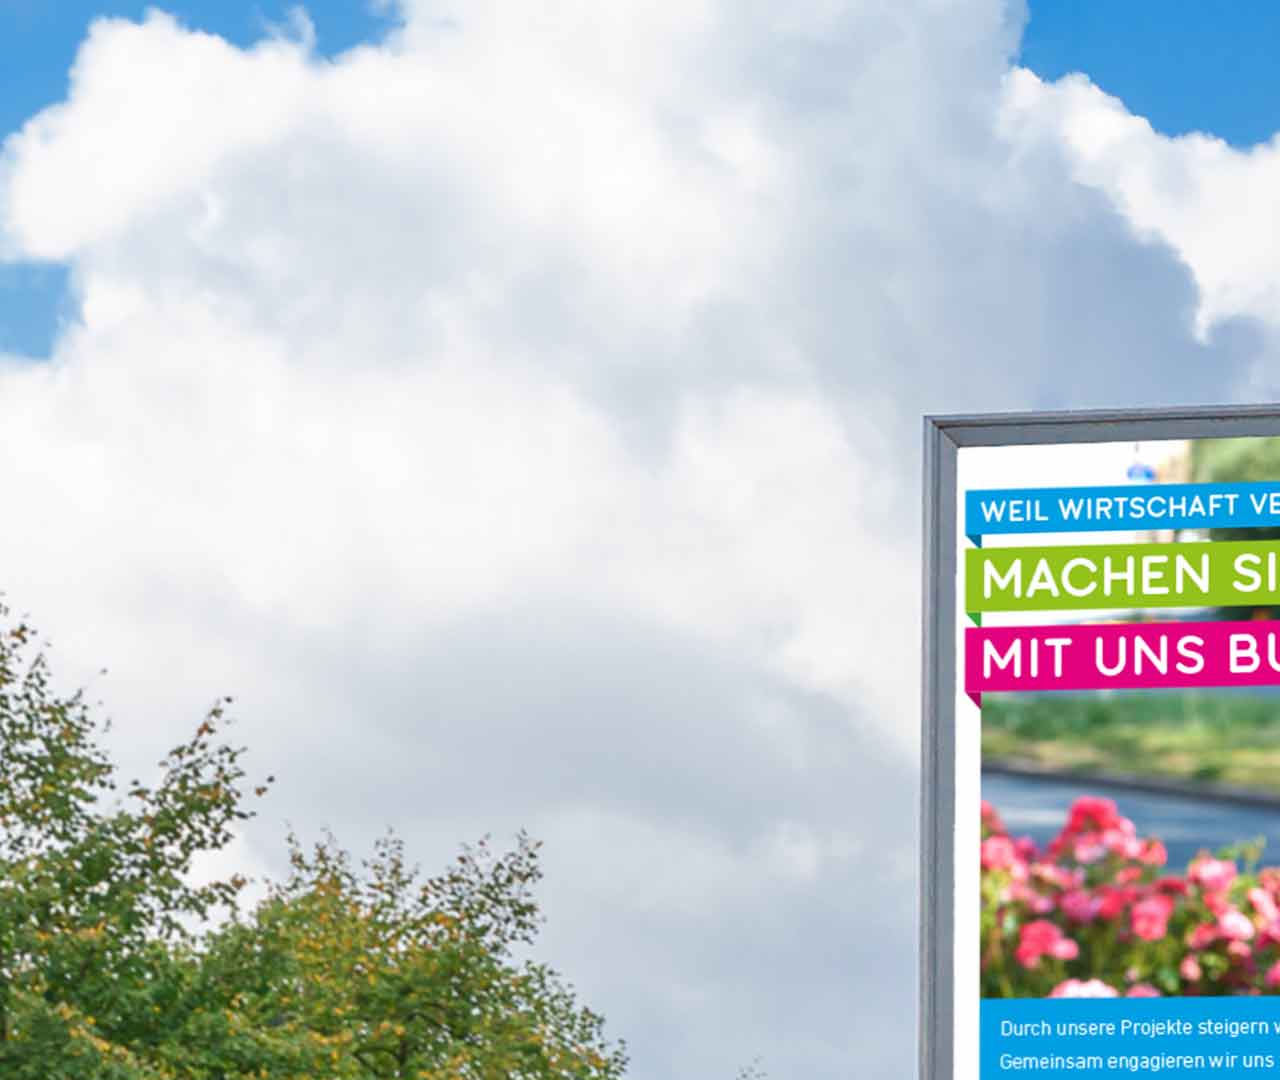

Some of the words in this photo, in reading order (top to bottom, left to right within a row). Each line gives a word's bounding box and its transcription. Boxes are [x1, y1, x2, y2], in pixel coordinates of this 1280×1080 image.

[981, 500, 1049, 522] WEIL
[1058, 493, 1239, 520] WIRTSCHAFT
[983, 553, 1210, 599] MACHEN
[982, 637, 1072, 680] MIT
[1093, 633, 1206, 676] UNS
[1000, 1020, 1052, 1036] Durch
[1056, 1022, 1116, 1036] unsere
[1120, 1019, 1193, 1037] Projekte
[1197, 1019, 1269, 1037] steigern
[999, 1053, 1103, 1070] Gemeinsam
[1107, 1055, 1205, 1072] engagieren
[1208, 1054, 1238, 1068] wir
[1242, 1055, 1275, 1068] uns
